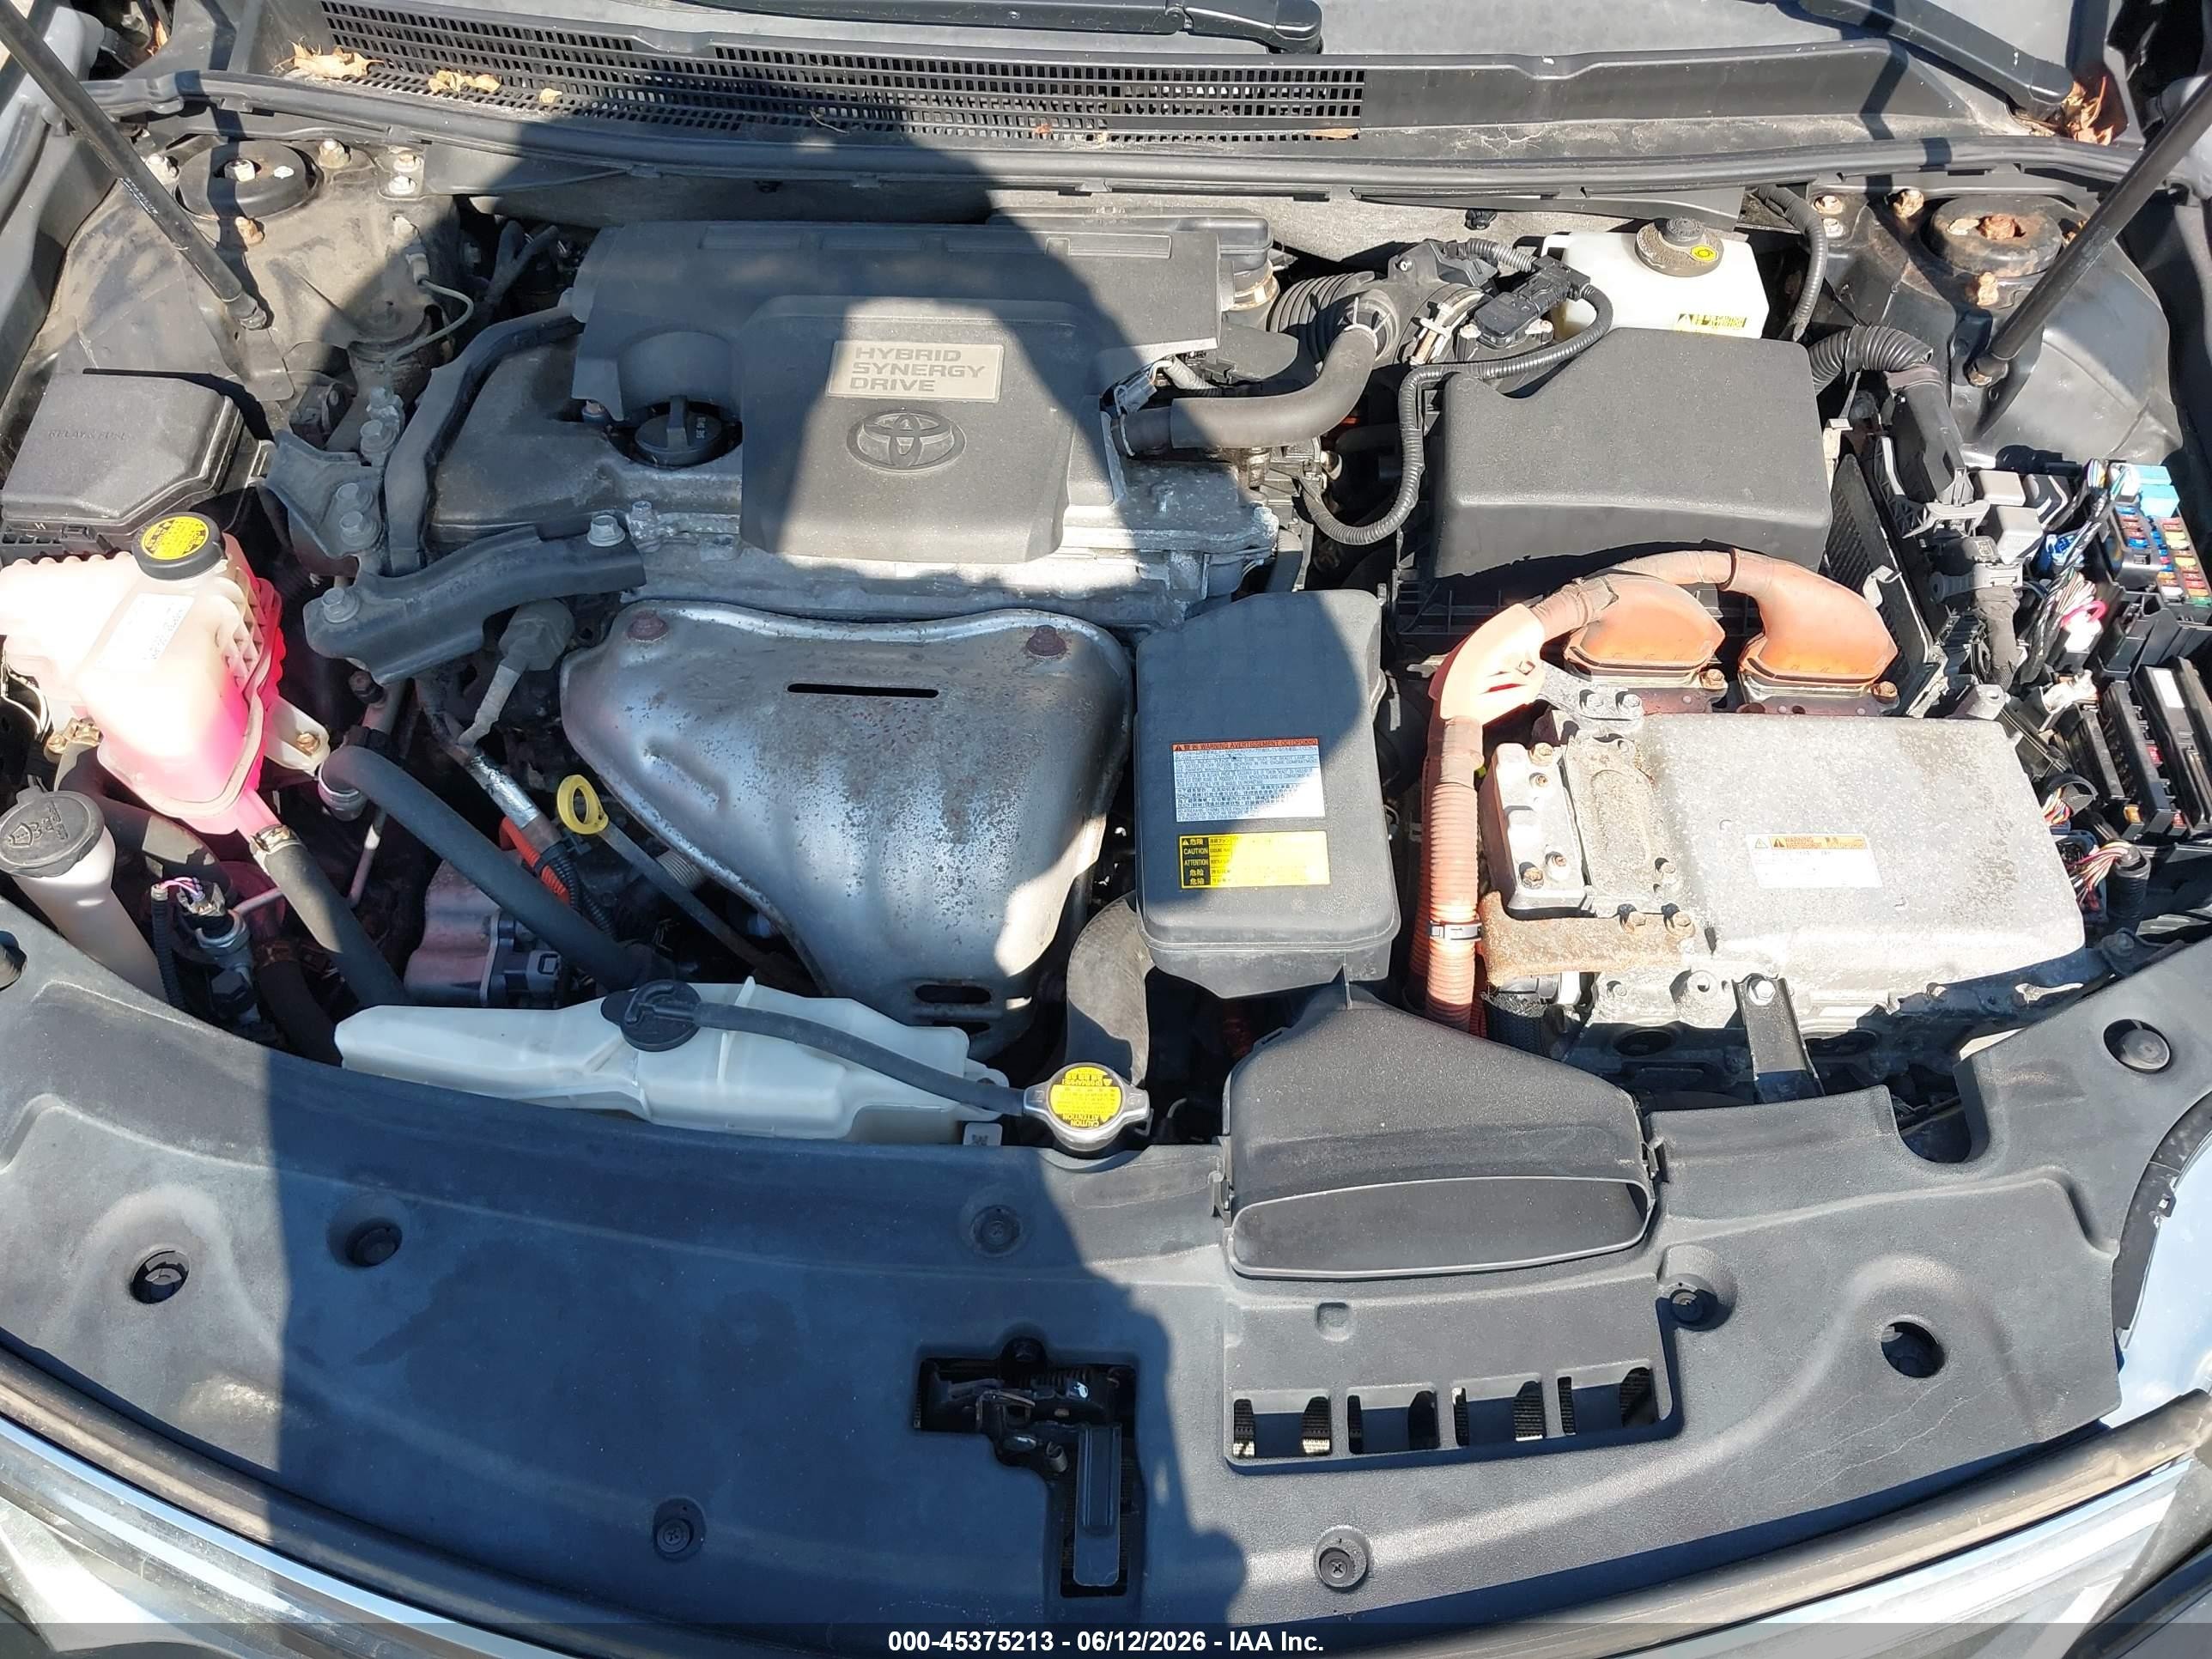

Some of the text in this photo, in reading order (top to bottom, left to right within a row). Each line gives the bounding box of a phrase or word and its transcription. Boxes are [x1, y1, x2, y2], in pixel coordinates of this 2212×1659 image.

[855, 348, 962, 362] HYBRID
[852, 362, 985, 378] SYNERGY
[849, 377, 935, 392] DRIVE
[1183, 847, 1208, 855] CAUTION
[1184, 858, 1208, 866] ATTENTION
